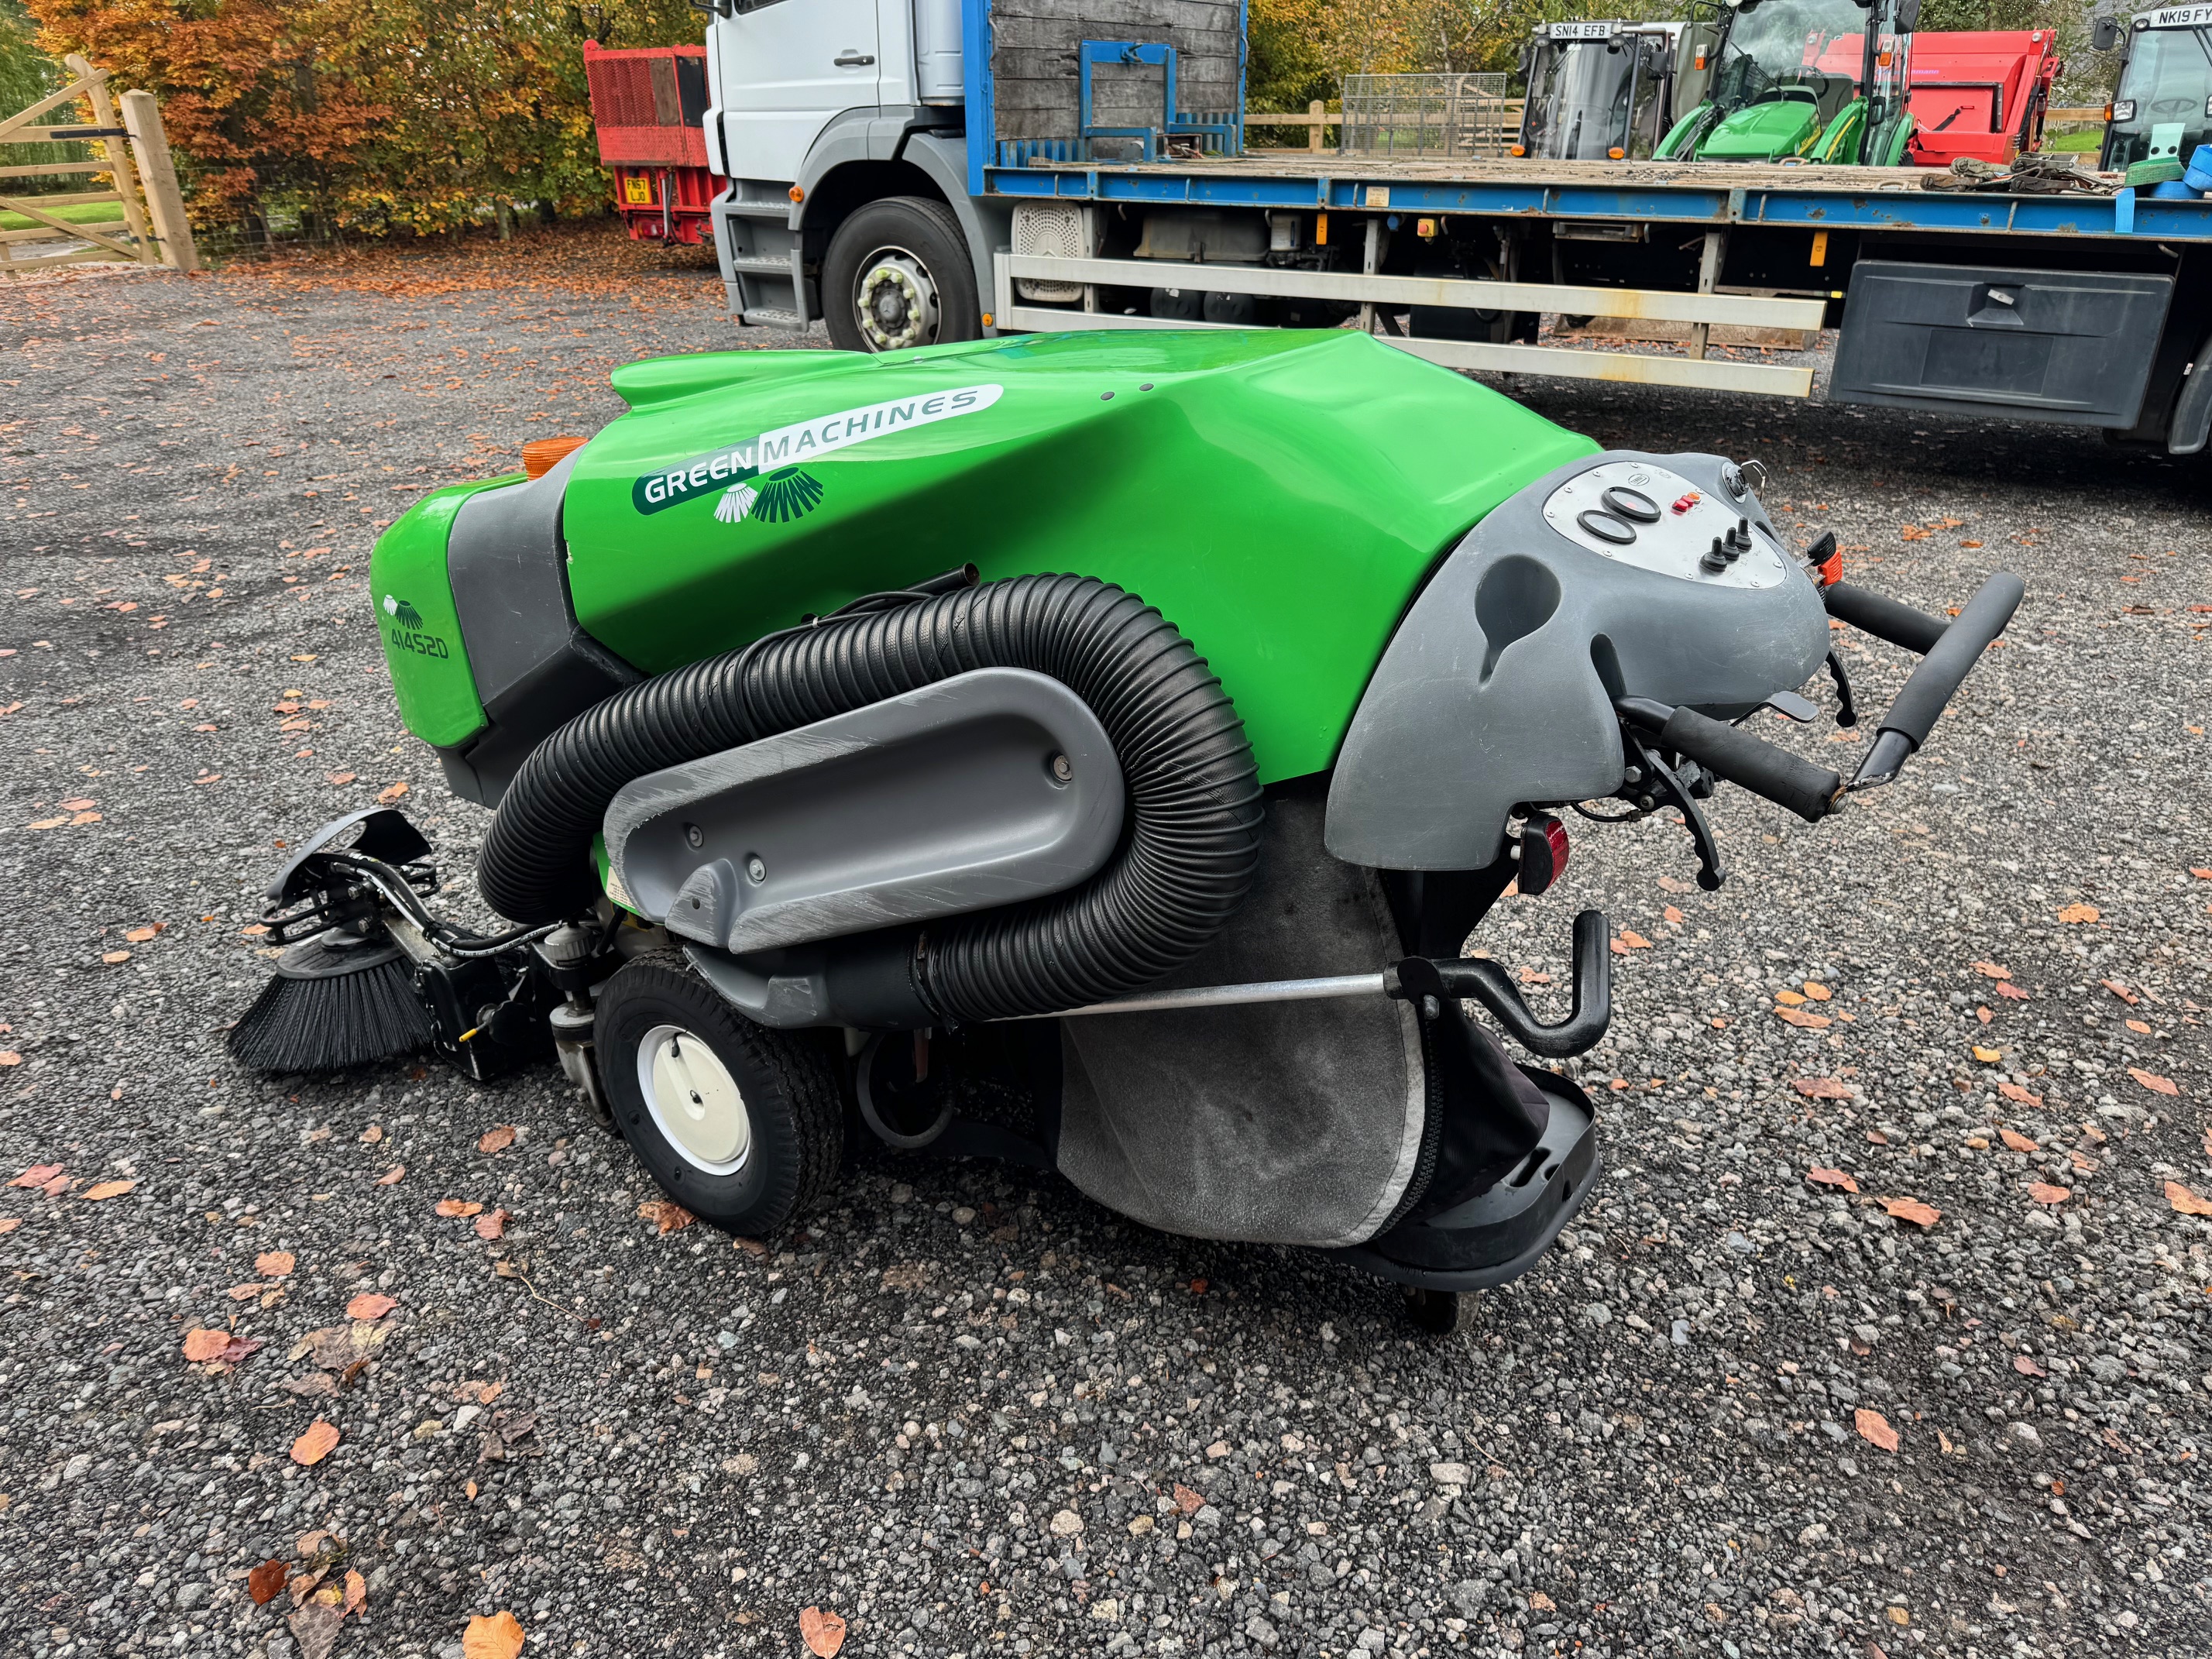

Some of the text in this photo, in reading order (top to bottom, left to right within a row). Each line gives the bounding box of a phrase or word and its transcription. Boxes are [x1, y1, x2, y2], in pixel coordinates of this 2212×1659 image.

[2159, 10, 2191, 24] NK19
[1555, 25, 1606, 36] SN14 EFB
[644, 390, 979, 504] GREEN MACHINES
